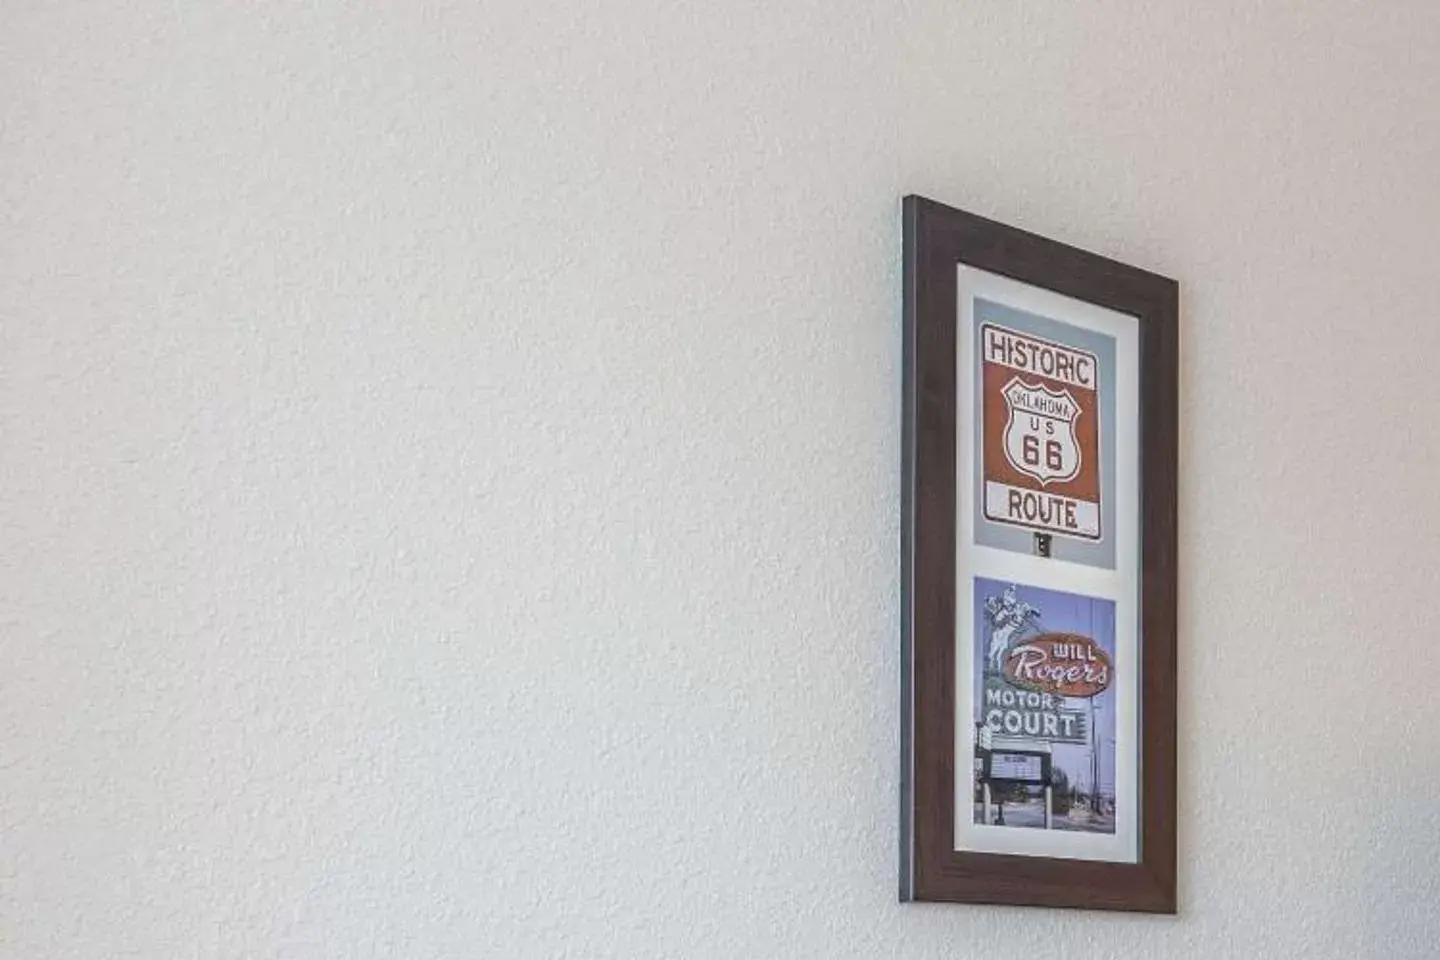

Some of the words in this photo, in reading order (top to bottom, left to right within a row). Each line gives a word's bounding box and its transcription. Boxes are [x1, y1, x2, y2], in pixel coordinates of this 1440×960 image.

[989, 332, 1090, 385] HISTORIC
[1013, 390, 1071, 419] OKLAHOMA
[1023, 435, 1063, 471] 66
[1008, 489, 1078, 528] ROUTE
[1010, 645, 1108, 687] Rogers
[1052, 642, 1097, 661] WILL
[986, 689, 1053, 709] MOTOR
[986, 709, 1076, 736] COURT
